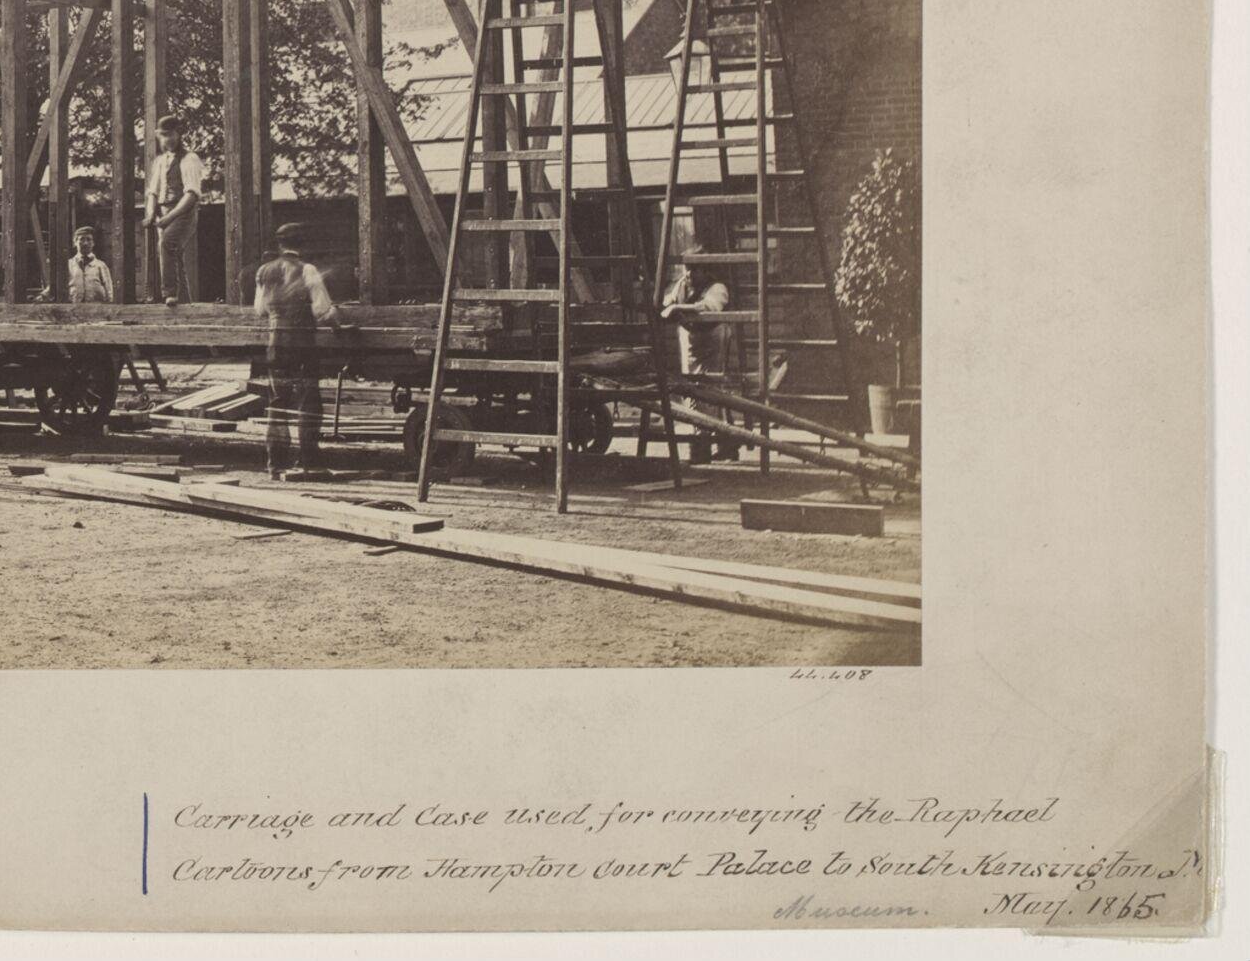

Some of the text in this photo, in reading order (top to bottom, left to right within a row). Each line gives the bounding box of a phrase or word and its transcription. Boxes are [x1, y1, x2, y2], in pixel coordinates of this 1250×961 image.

[173, 796, 316, 839] Carriage
[327, 803, 407, 827] and
[414, 803, 490, 827] Case
[586, 801, 655, 834] for
[661, 795, 826, 836] conveying
[843, 797, 896, 825] the
[894, 796, 1060, 839] Raphael
[172, 855, 314, 882] Cartoons
[306, 859, 413, 891] from
[423, 854, 588, 894] Hampton
[696, 849, 813, 878] Palace
[822, 850, 853, 876] to
[855, 849, 962, 878] South
[960, 845, 1159, 892] Kensington
